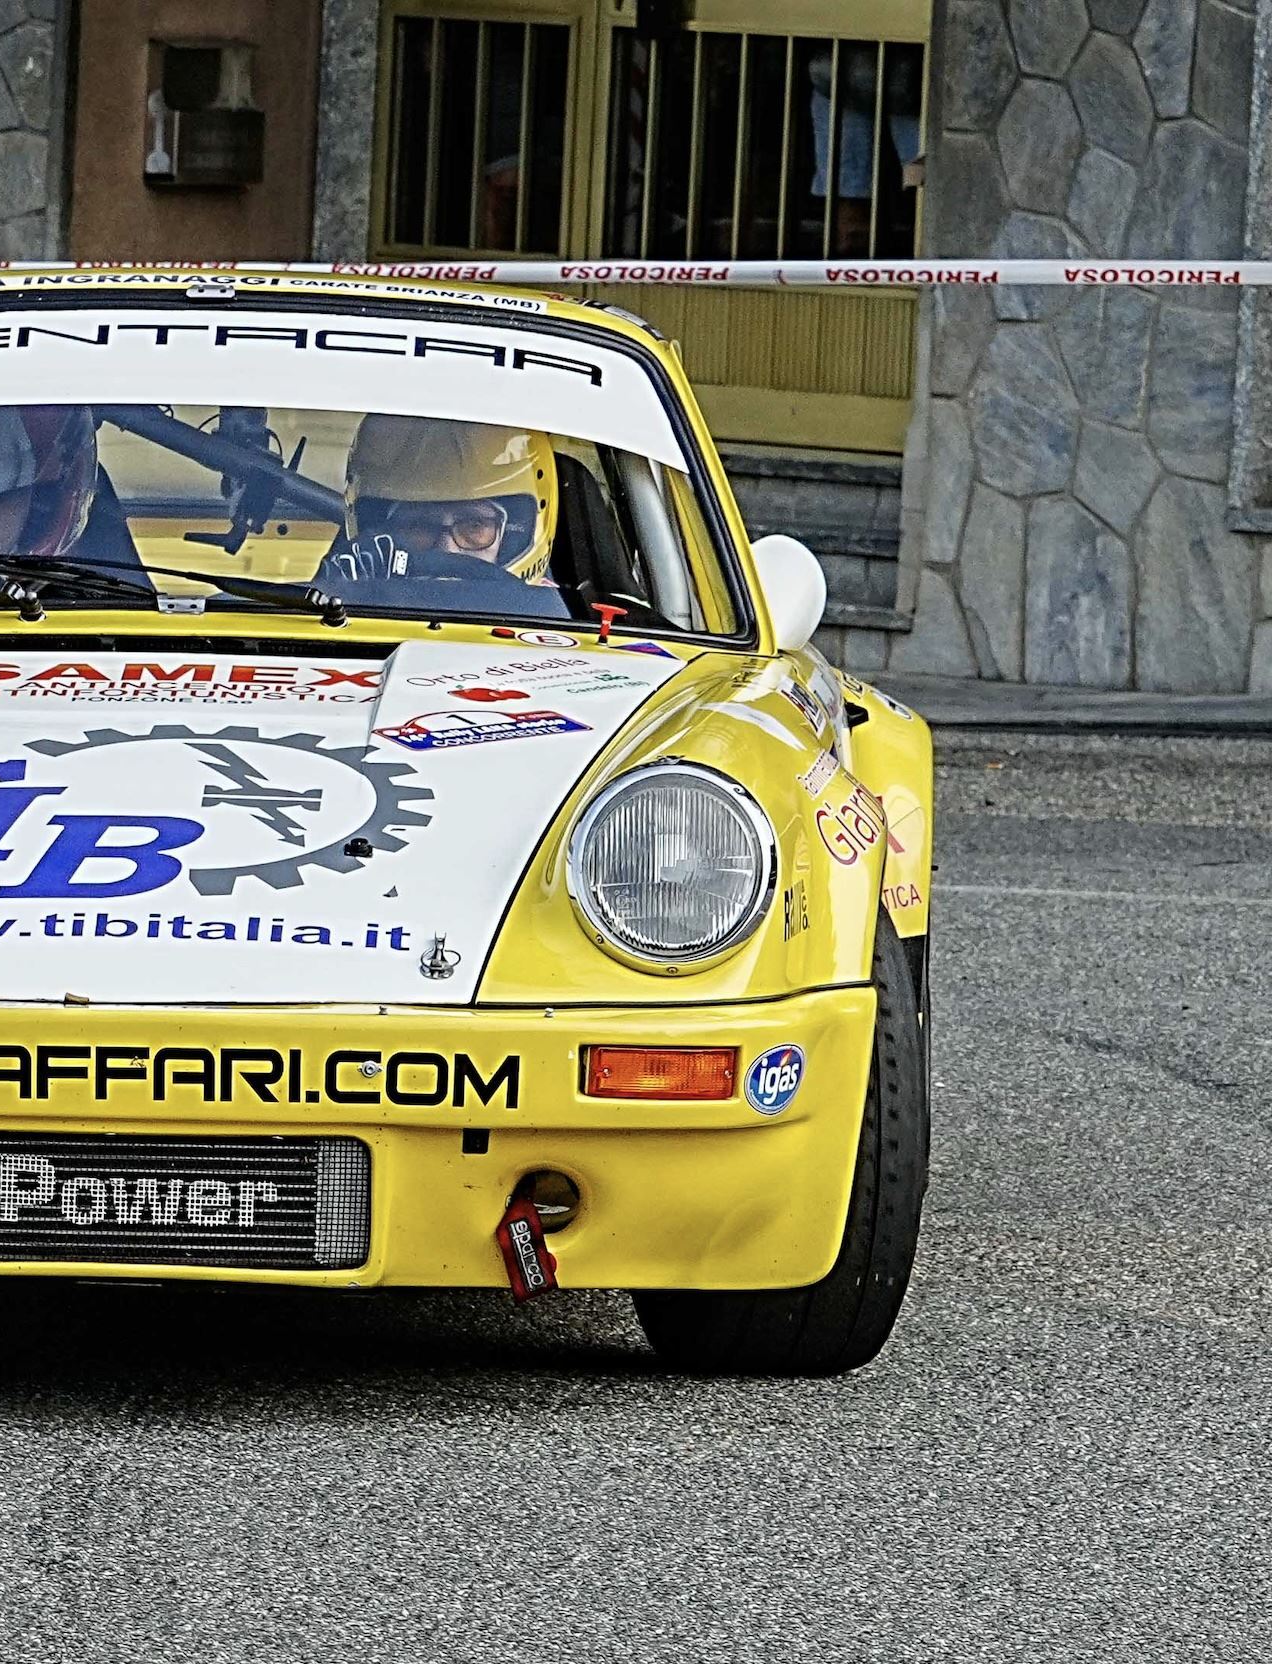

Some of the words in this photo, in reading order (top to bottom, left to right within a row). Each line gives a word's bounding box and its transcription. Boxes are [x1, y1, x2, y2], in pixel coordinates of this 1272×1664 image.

[331, 262, 498, 281] PERICOLOSA
[560, 266, 729, 283] PERICOLOSA
[826, 268, 999, 284] PERICOLOSA
[1064, 268, 1241, 284] PERICOLOSA
[23, 274, 280, 287] INGRANAGGI
[289, 279, 378, 291] CARATE
[385, 285, 486, 302] BRIANZA
[493, 296, 542, 312] (MB)
[406, 673, 480, 687] Orto
[485, 666, 515, 676] di
[508, 658, 591, 672] Biella
[17, 681, 318, 694] ANTINCENDIO
[432, 726, 566, 748] CONCORRENTE
[758, 1057, 800, 1105] igas
